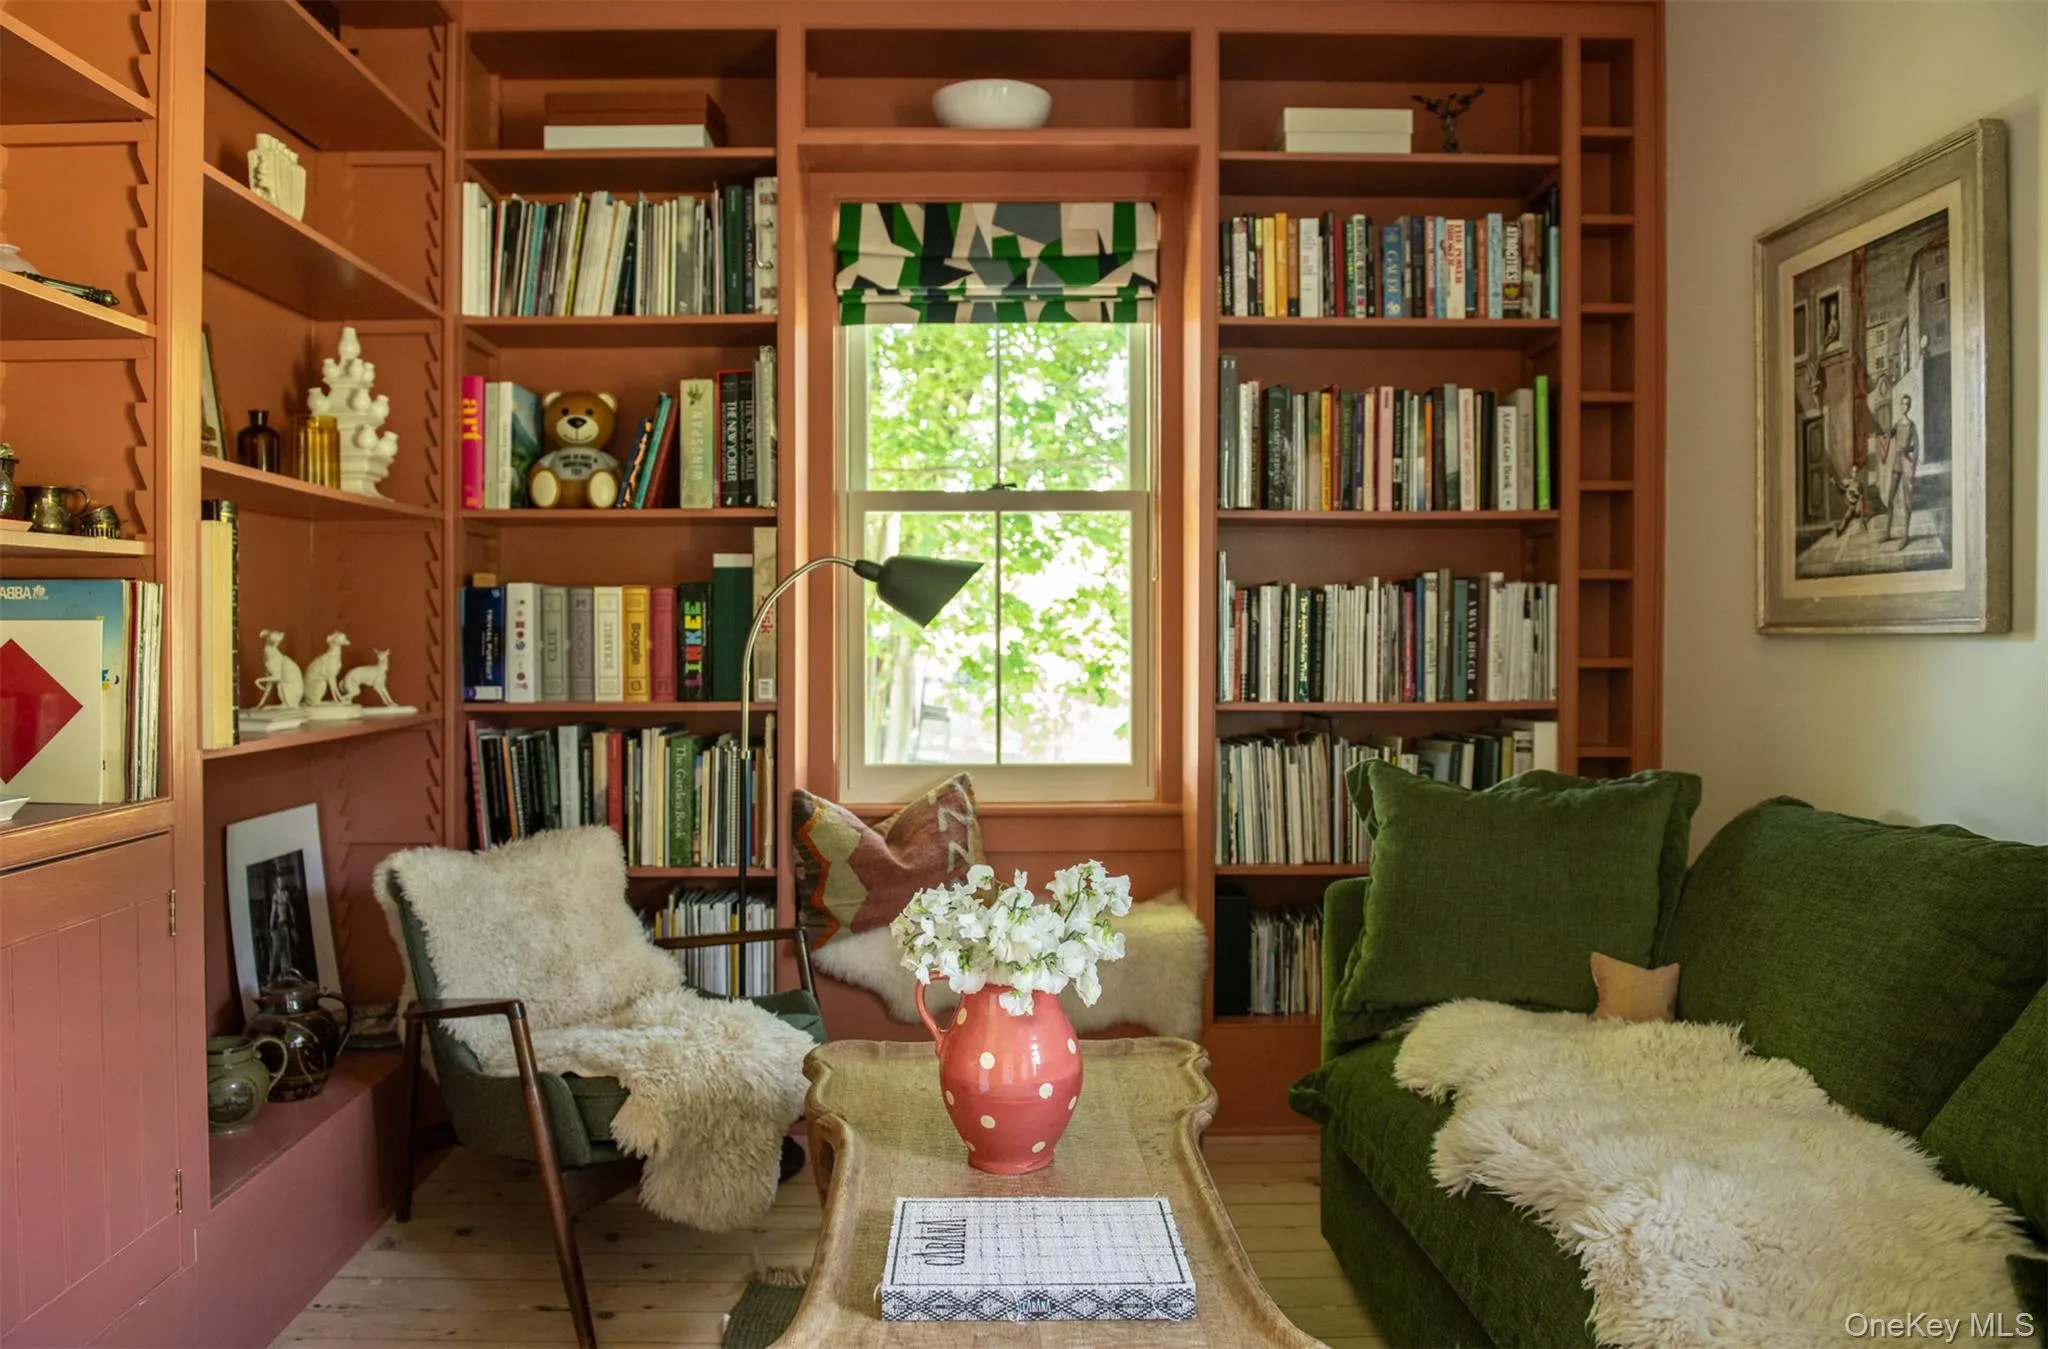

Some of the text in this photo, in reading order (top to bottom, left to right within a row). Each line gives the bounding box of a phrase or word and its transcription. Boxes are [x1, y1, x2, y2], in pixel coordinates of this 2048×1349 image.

[1505, 226, 1520, 280] ATROCITIES
[463, 398, 483, 441] art
[745, 418, 754, 441] NEW
[1503, 419, 1512, 445] Great
[690, 409, 704, 482] WINGSPAN
[727, 401, 738, 482] THE NEW YORKER
[1502, 446, 1511, 463] Gay
[1503, 465, 1512, 489] Book
[1300, 596, 1308, 613] The
[1468, 608, 1477, 629] MAN
[485, 609, 494, 680] TRIVIAL PURSUIT
[630, 622, 642, 666] Boggle
[685, 601, 703, 687] LINKEE
[1468, 641, 1477, 658] HIS
[1468, 660, 1477, 680] CAR
[674, 744, 687, 840] The Garden Book
[912, 1218, 967, 1267] CABANA
